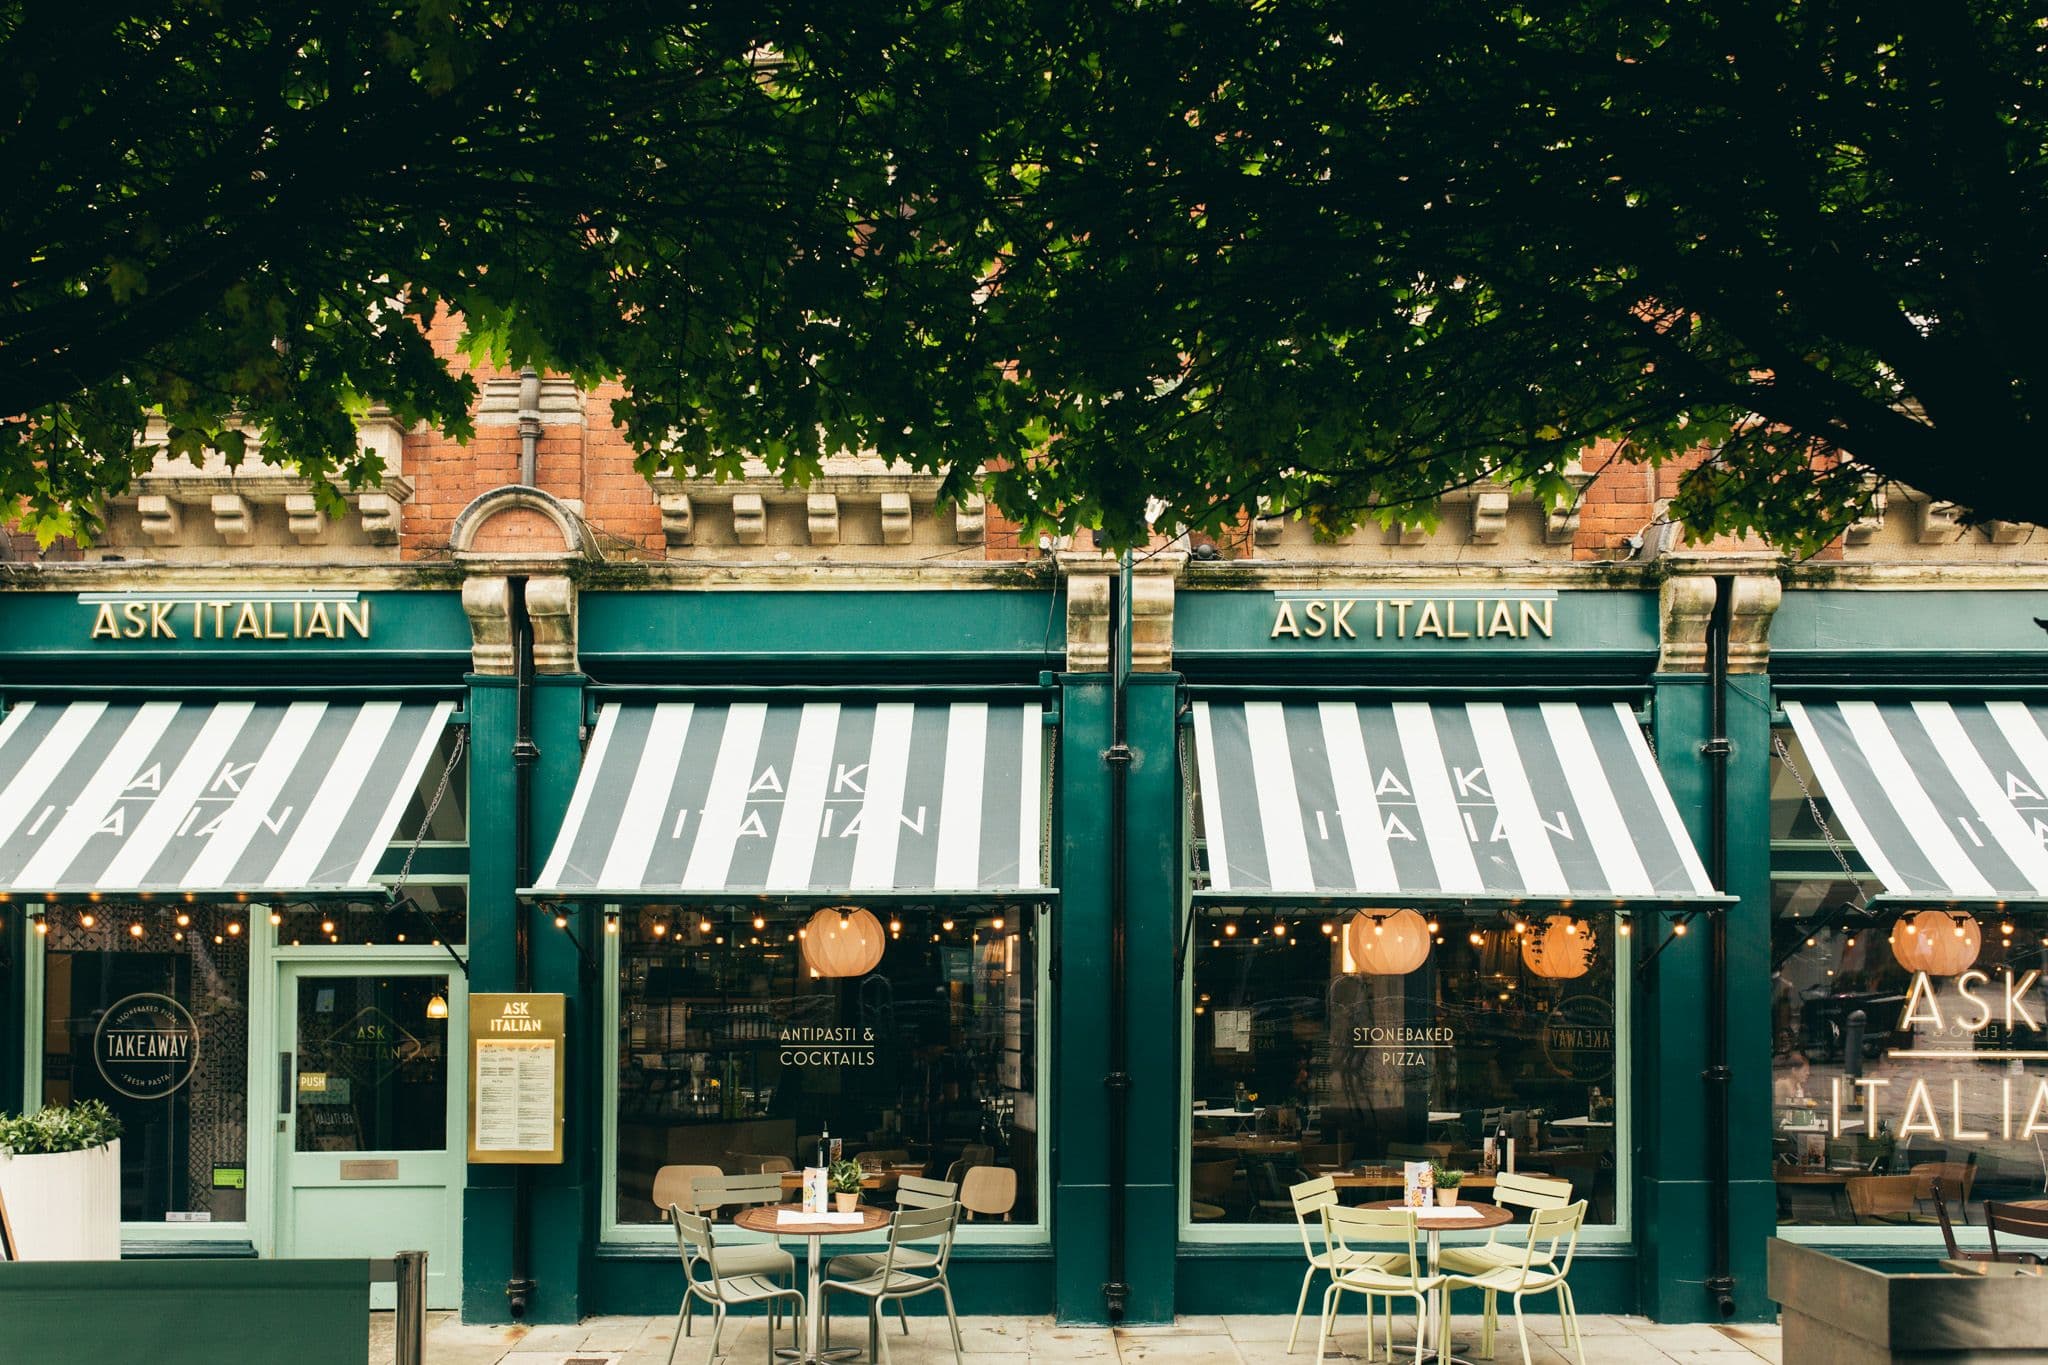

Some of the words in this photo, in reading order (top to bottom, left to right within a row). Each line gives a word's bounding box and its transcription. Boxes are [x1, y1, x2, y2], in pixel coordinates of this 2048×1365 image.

[91, 601, 176, 639] ASK
[193, 601, 370, 639] ITALIAN
[1271, 600, 1356, 638] ASK
[1376, 600, 1553, 638] ITALIAN
[124, 762, 257, 792] AK
[748, 764, 870, 793] AK
[1375, 766, 1493, 797] AK
[503, 1002, 529, 1015] ASK
[1899, 970, 2042, 1032] ASK
[357, 1025, 385, 1040] ASK
[490, 1019, 542, 1032] ITALIAN
[780, 1027, 857, 1042] ANTIPASTI
[863, 1027, 875, 1042] &
[1353, 1027, 1454, 1042] STONEBAKED
[107, 1034, 188, 1057] TAKEAWAY
[780, 1051, 875, 1066] COCKTAILS
[1382, 1051, 1426, 1066] PIZZA
[301, 1076, 325, 1087] PUSH
